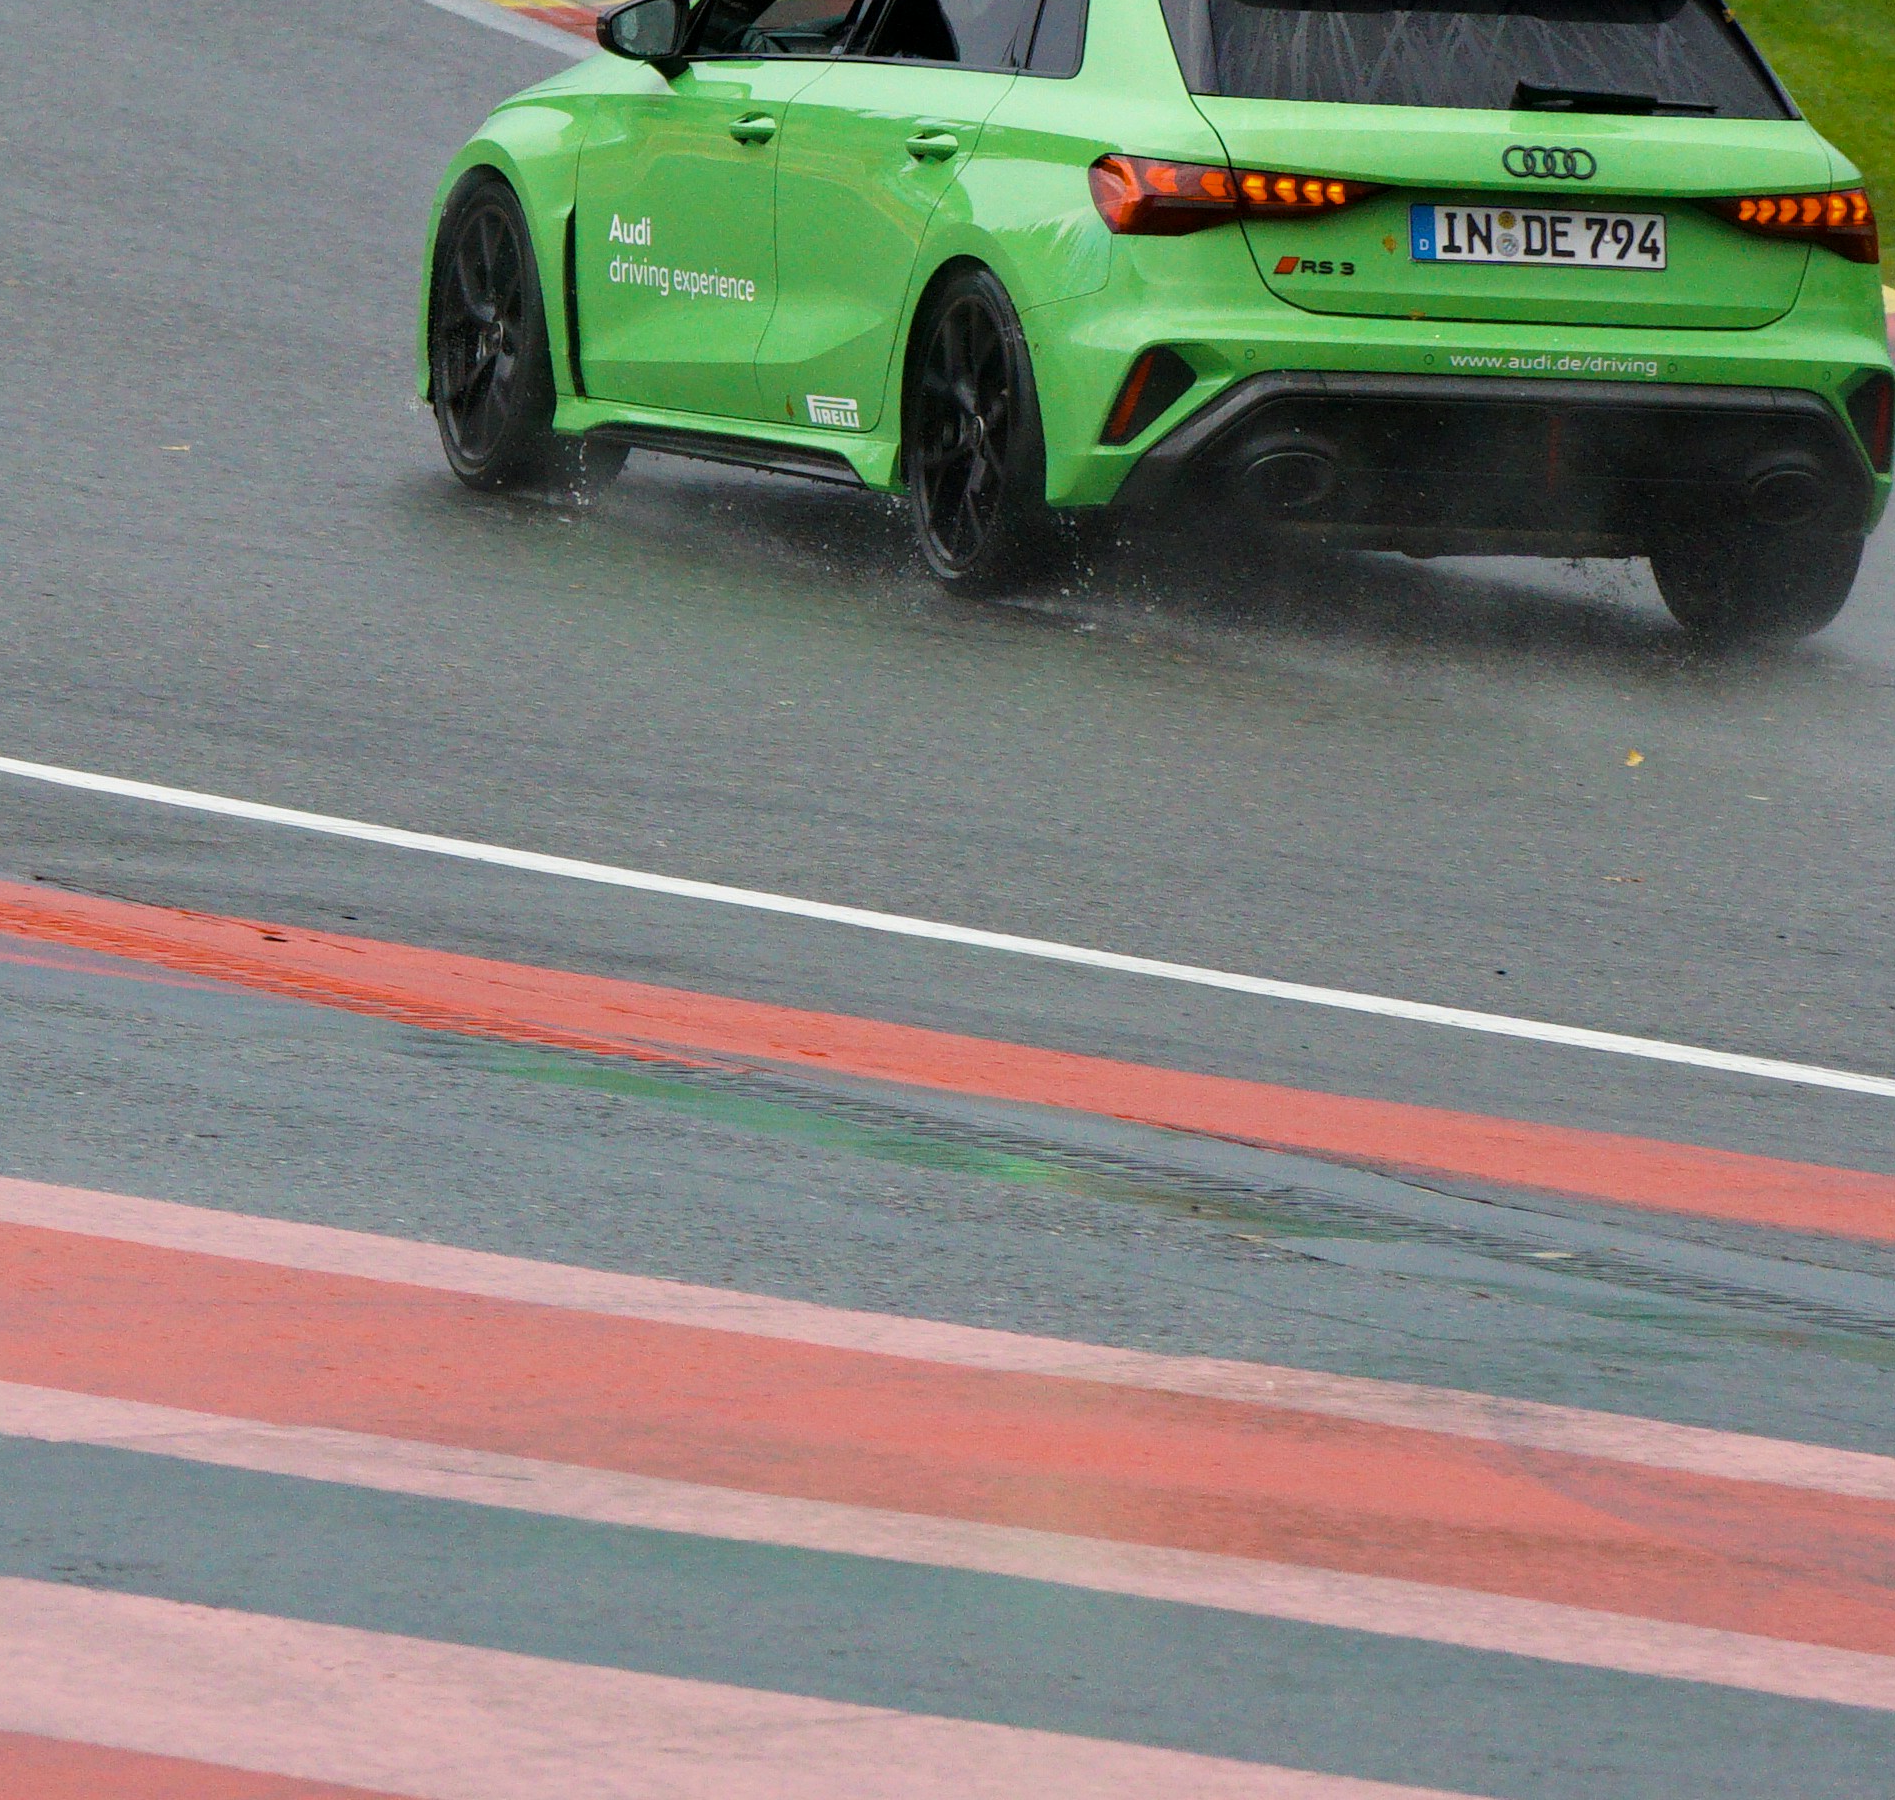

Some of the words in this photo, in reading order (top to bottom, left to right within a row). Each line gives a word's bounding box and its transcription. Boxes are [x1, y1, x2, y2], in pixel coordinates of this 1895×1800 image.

[608, 213, 652, 247] Audi
[1419, 238, 1430, 251] D
[1441, 212, 1493, 255] IN
[1521, 215, 1576, 259] DE
[1585, 217, 1661, 263] 794
[608, 254, 670, 297] driving
[672, 266, 756, 302] experience
[1300, 260, 1334, 275] RS
[1339, 261, 1355, 276] 3
[1449, 353, 1658, 377] www.audi.de/driving
[805, 394, 860, 429] PIRELLI
